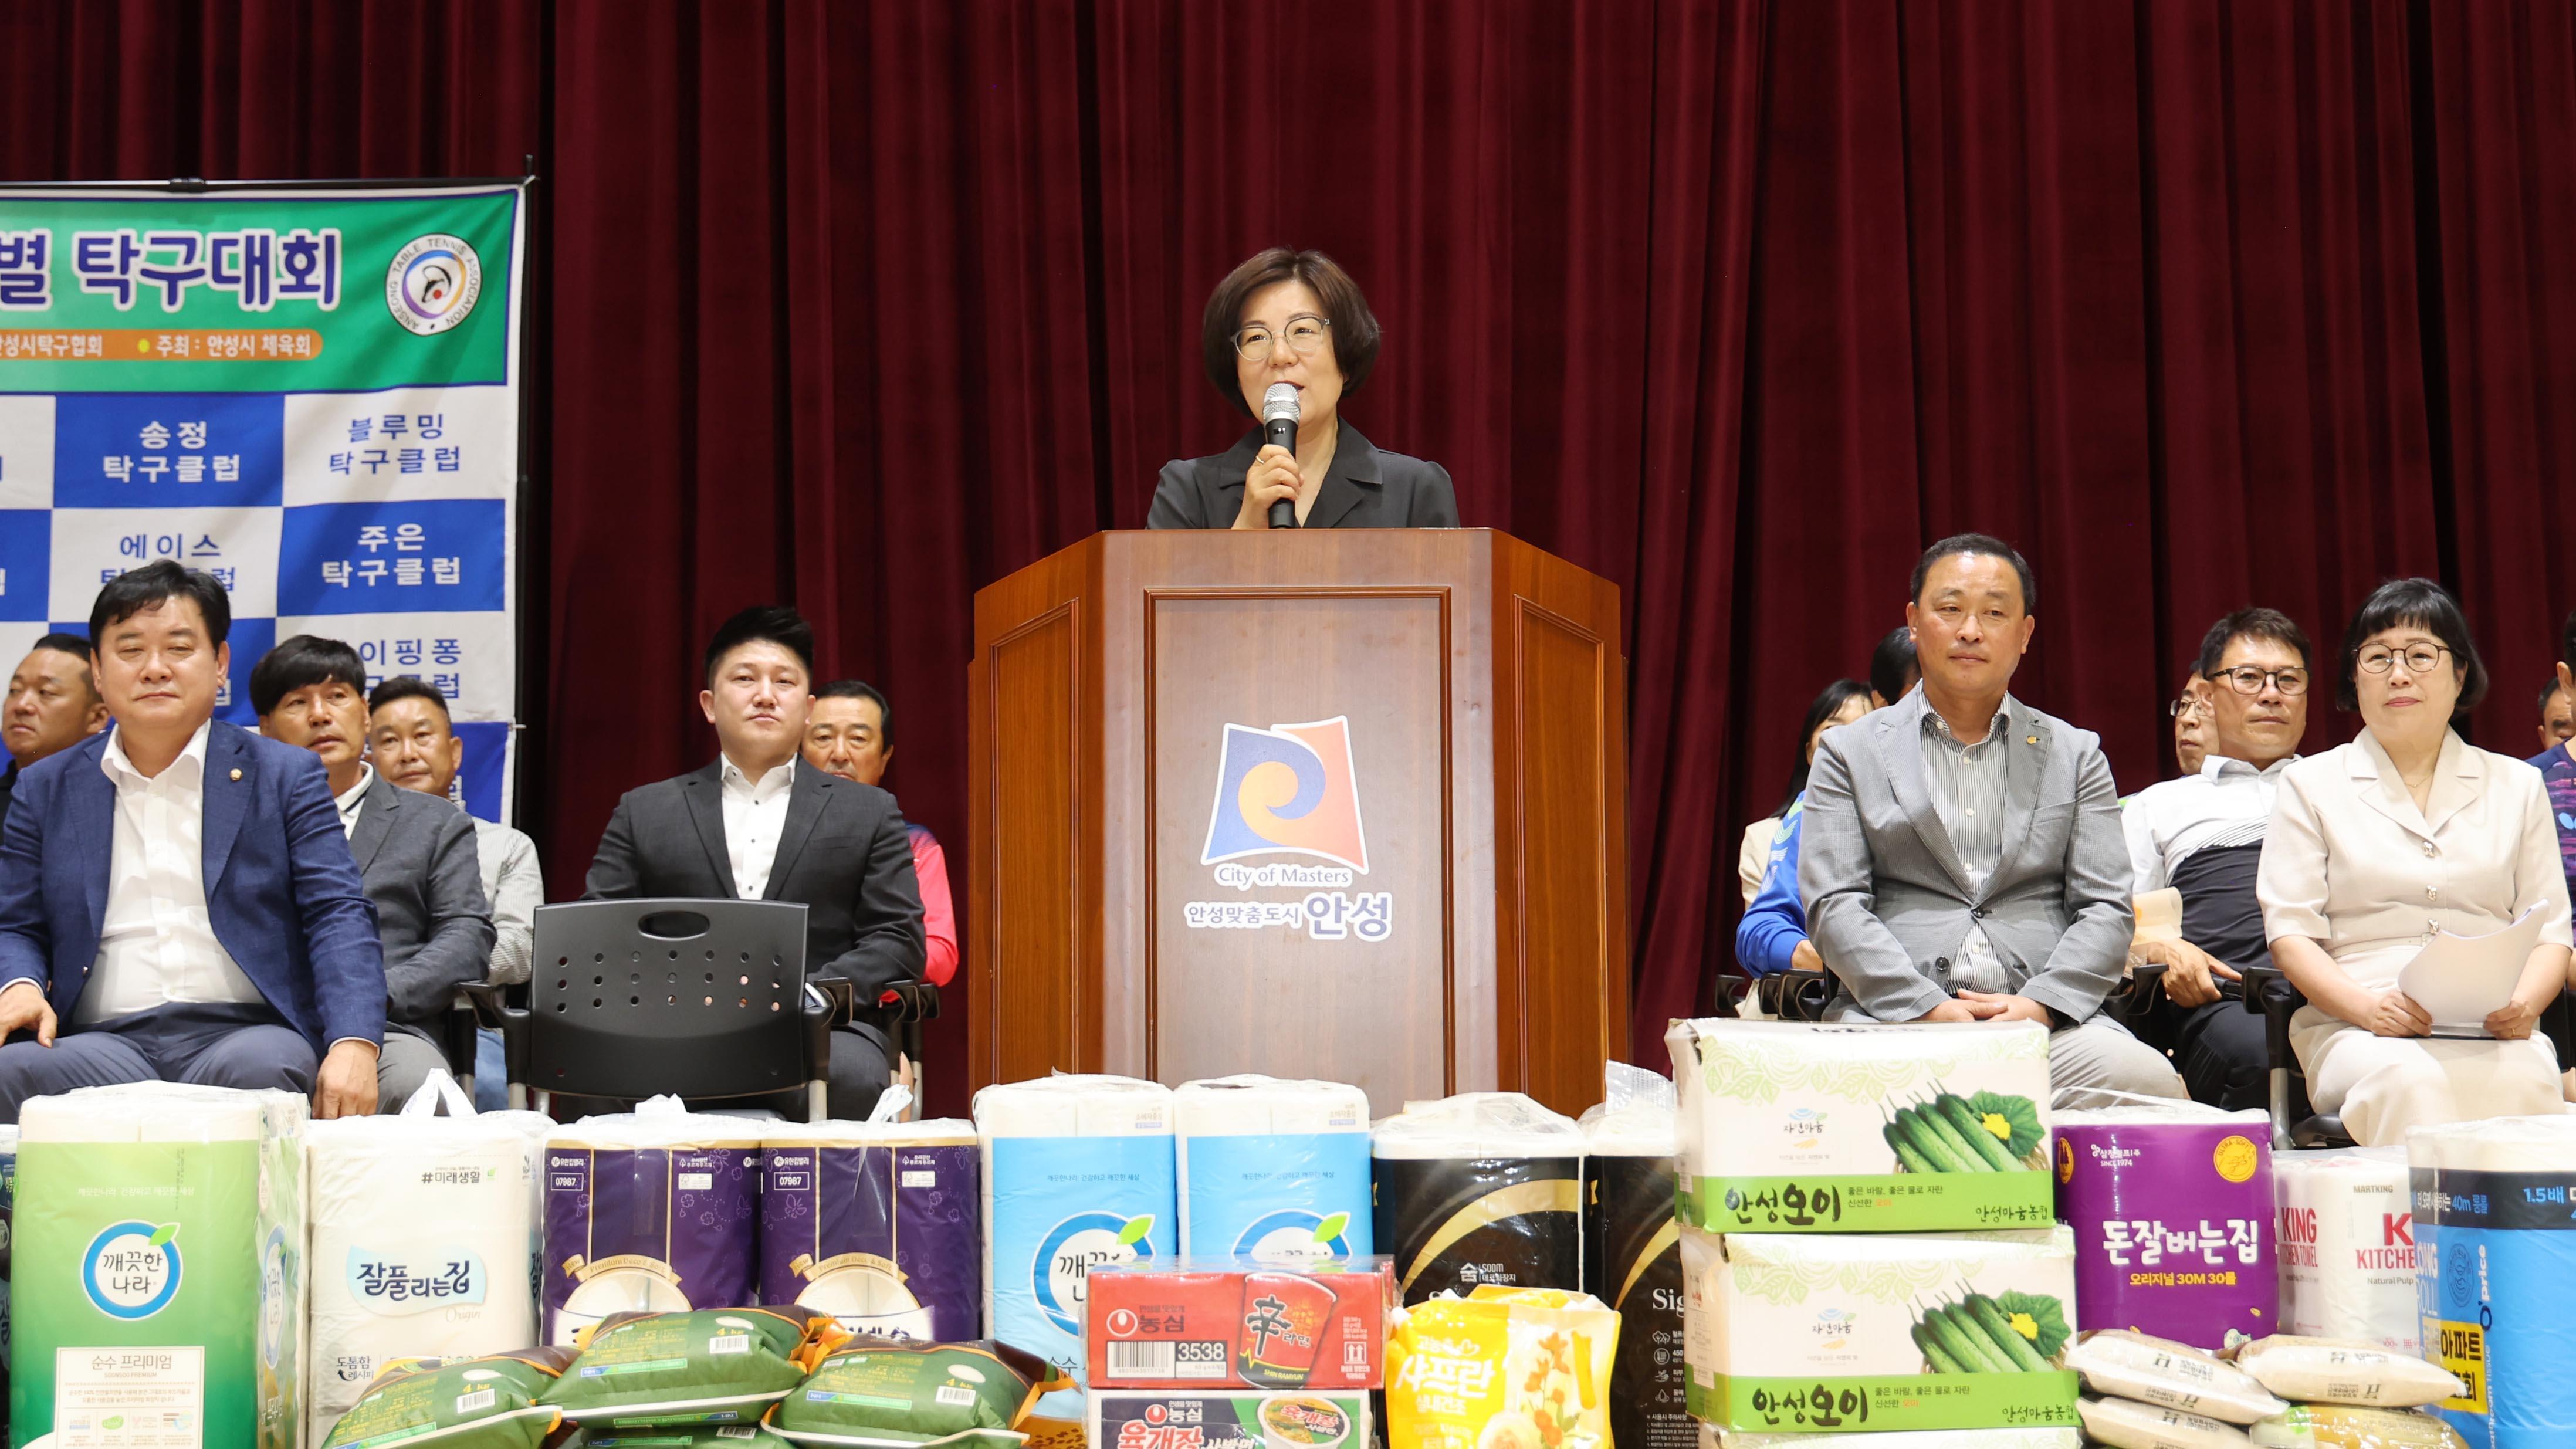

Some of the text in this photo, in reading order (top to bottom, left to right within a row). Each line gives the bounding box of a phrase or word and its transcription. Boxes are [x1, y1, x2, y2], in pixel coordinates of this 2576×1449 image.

[392, 244, 422, 272] TABLE
[427, 238, 467, 255] TENNIS
[79, 235, 335, 306] 탁구대회
[157, 334, 189, 357] 주최
[207, 334, 255, 357] 안성시
[262, 334, 312, 357] 체육회
[139, 420, 208, 450] 송정
[348, 413, 444, 443] 블루밍
[103, 454, 240, 483] 탁구클럽
[329, 446, 461, 475] 탁구클럽
[120, 533, 221, 559] 에이스
[358, 523, 426, 553] 주은
[321, 556, 461, 588] 탁구클럽
[358, 638, 462, 666] 이핑퐁
[1218, 868, 1349, 886] City of Masters
[1189, 896, 1388, 937] 안성맞춤도시 안성
[421, 1171, 480, 1184] #미래생활
[779, 1176, 802, 1186] 07987
[1848, 1186, 1863, 1195] 좋은
[1888, 1186, 1904, 1194] 좋은
[1908, 1185, 1924, 1194] 물로
[1927, 1185, 1944, 1194] 자란
[2353, 1185, 2394, 1194] MARTKING
[2523, 1186, 2565, 1204] 1.5배
[1848, 1199, 1872, 1208] 신선한
[2452, 1194, 2472, 1211] 40m
[2281, 1207, 2317, 1244] KING
[2102, 1219, 2258, 1265] 돈잘버는집
[103, 1251, 163, 1272] 깨끗한
[590, 1258, 622, 1272] Premium
[819, 1257, 850, 1271] Premium
[2416, 1241, 2439, 1278] ONG
[113, 1275, 151, 1294] 나라
[357, 1260, 470, 1301] 잘풀리는집
[2130, 1271, 2175, 1287] 오리지널
[2176, 1272, 2206, 1285] 30M
[2367, 1277, 2414, 1286] Natural Pulp
[716, 1328, 726, 1336] 4
[1139, 1315, 1185, 1333] 농심
[1245, 1294, 1293, 1357] 辛
[1282, 1332, 1311, 1347] 라면
[2440, 1329, 2482, 1361] 아파트
[1177, 1342, 1225, 1361] 3538
[92, 1355, 172, 1370] 순수 프리미엄
[336, 1356, 371, 1370] 도톰함
[348, 1370, 374, 1380] 레시피
[946, 1378, 956, 1387] 4
[1264, 1369, 1304, 1380] SHIN RAMYUN
[462, 1384, 473, 1393] 4
[1875, 1387, 1891, 1396] 좋은
[1916, 1386, 1932, 1396] 좋은
[1935, 1386, 1951, 1395] 물로
[1954, 1385, 1970, 1394] 자란
[1875, 1399, 1899, 1409] 신선한
[1168, 1407, 1203, 1423] 농심
[1280, 1404, 1339, 1428] 육개장
[1118, 1419, 1205, 1449] 육개장
